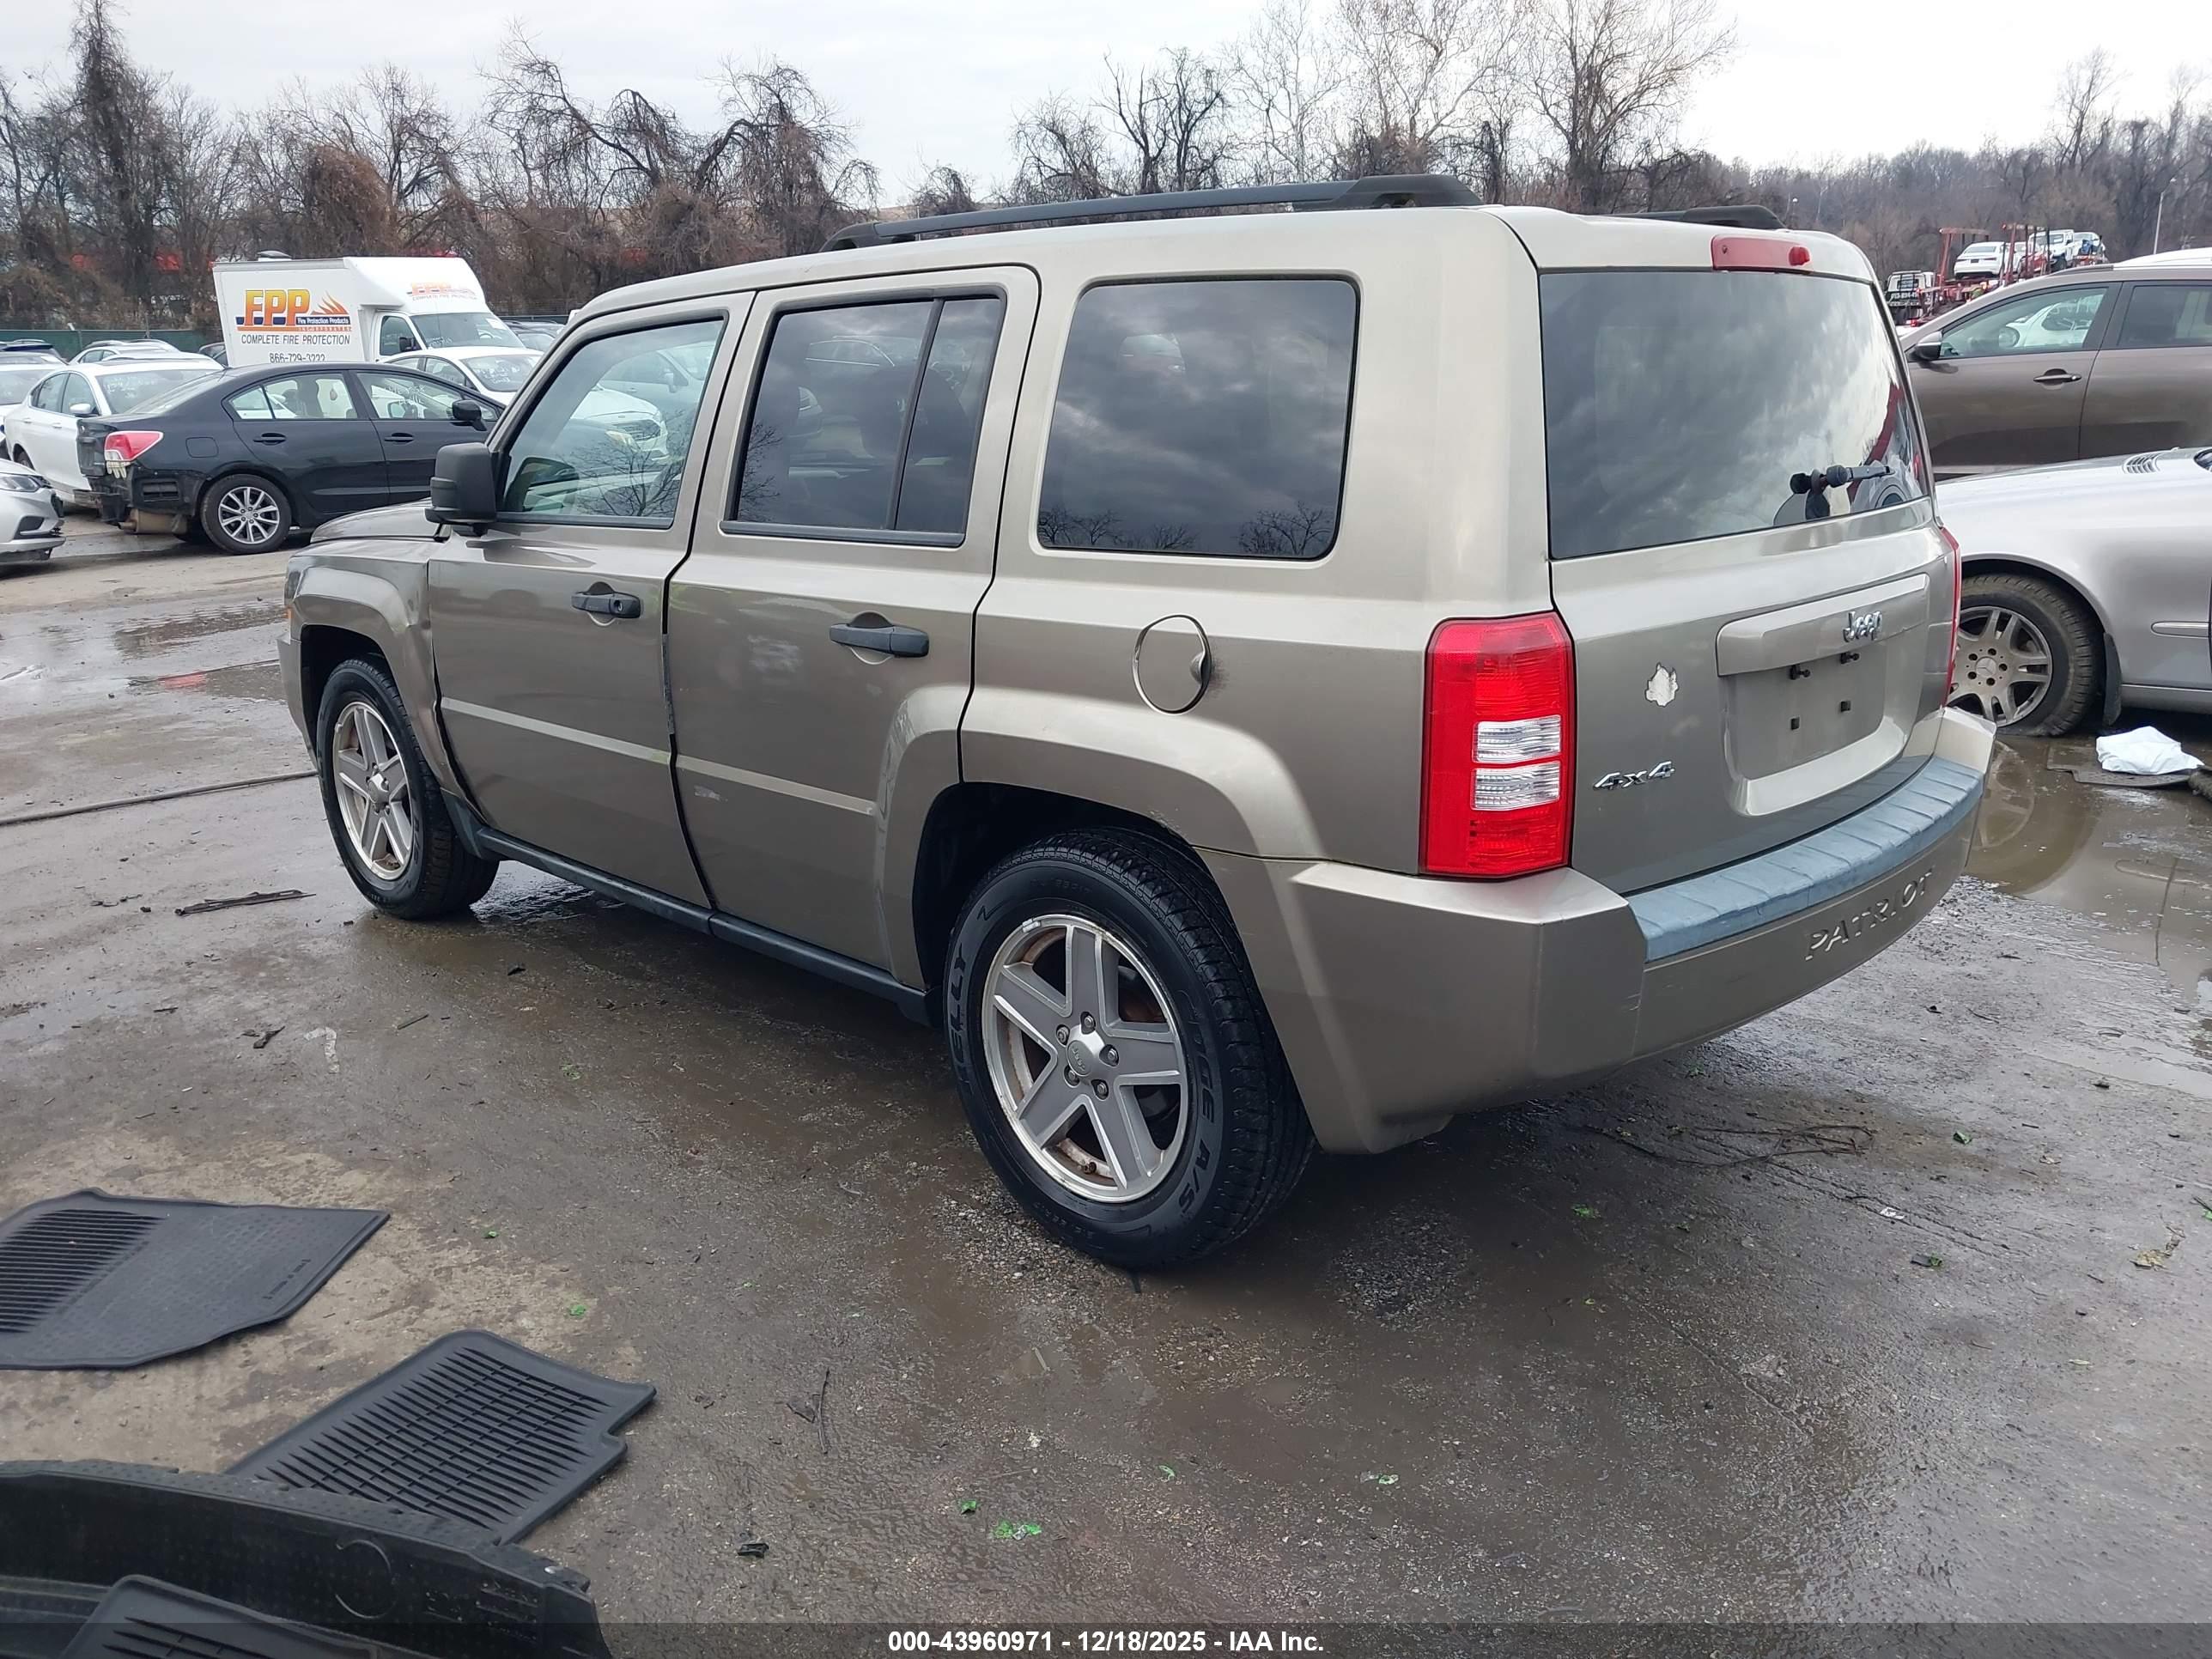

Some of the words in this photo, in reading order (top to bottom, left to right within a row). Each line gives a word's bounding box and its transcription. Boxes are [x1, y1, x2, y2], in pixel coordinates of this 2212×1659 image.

[244, 289, 310, 325] FPP
[241, 335, 280, 344] COMPLETE
[283, 335, 299, 344] FIRE
[303, 335, 350, 344] PROTECTION
[1843, 611, 1881, 641] Jeep
[1805, 869, 1933, 961] PATRIOT
